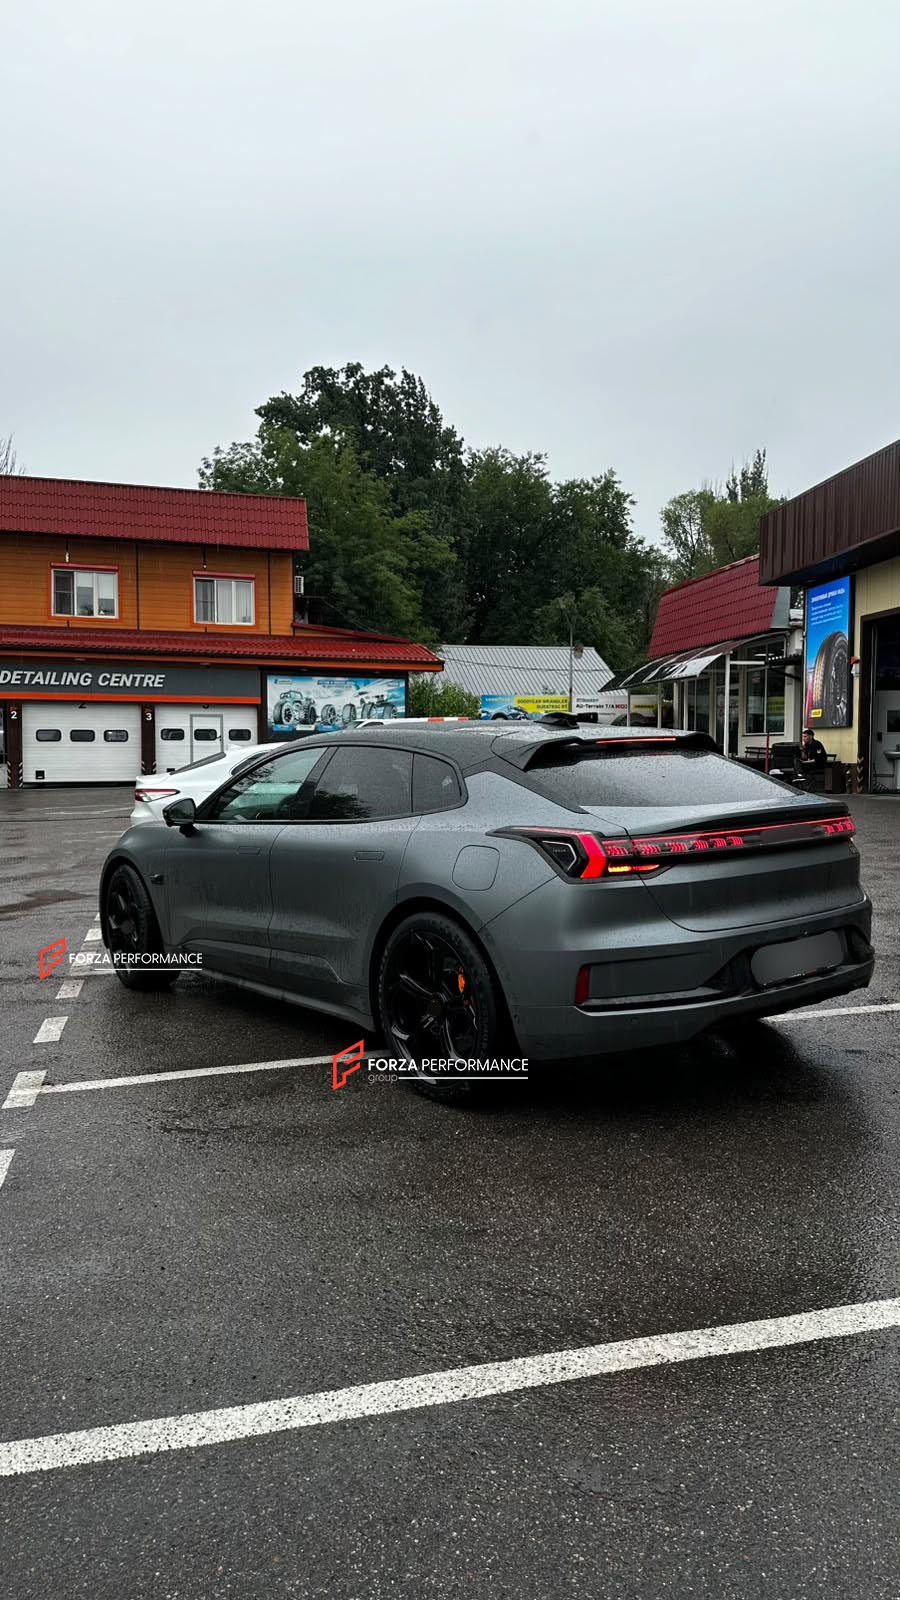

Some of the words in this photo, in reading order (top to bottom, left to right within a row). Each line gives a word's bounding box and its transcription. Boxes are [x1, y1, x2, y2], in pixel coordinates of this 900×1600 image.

[0, 670, 92, 685] DETAILING
[98, 673, 165, 687] CENTRE
[10, 710, 18, 719] 2
[146, 712, 152, 720] 3
